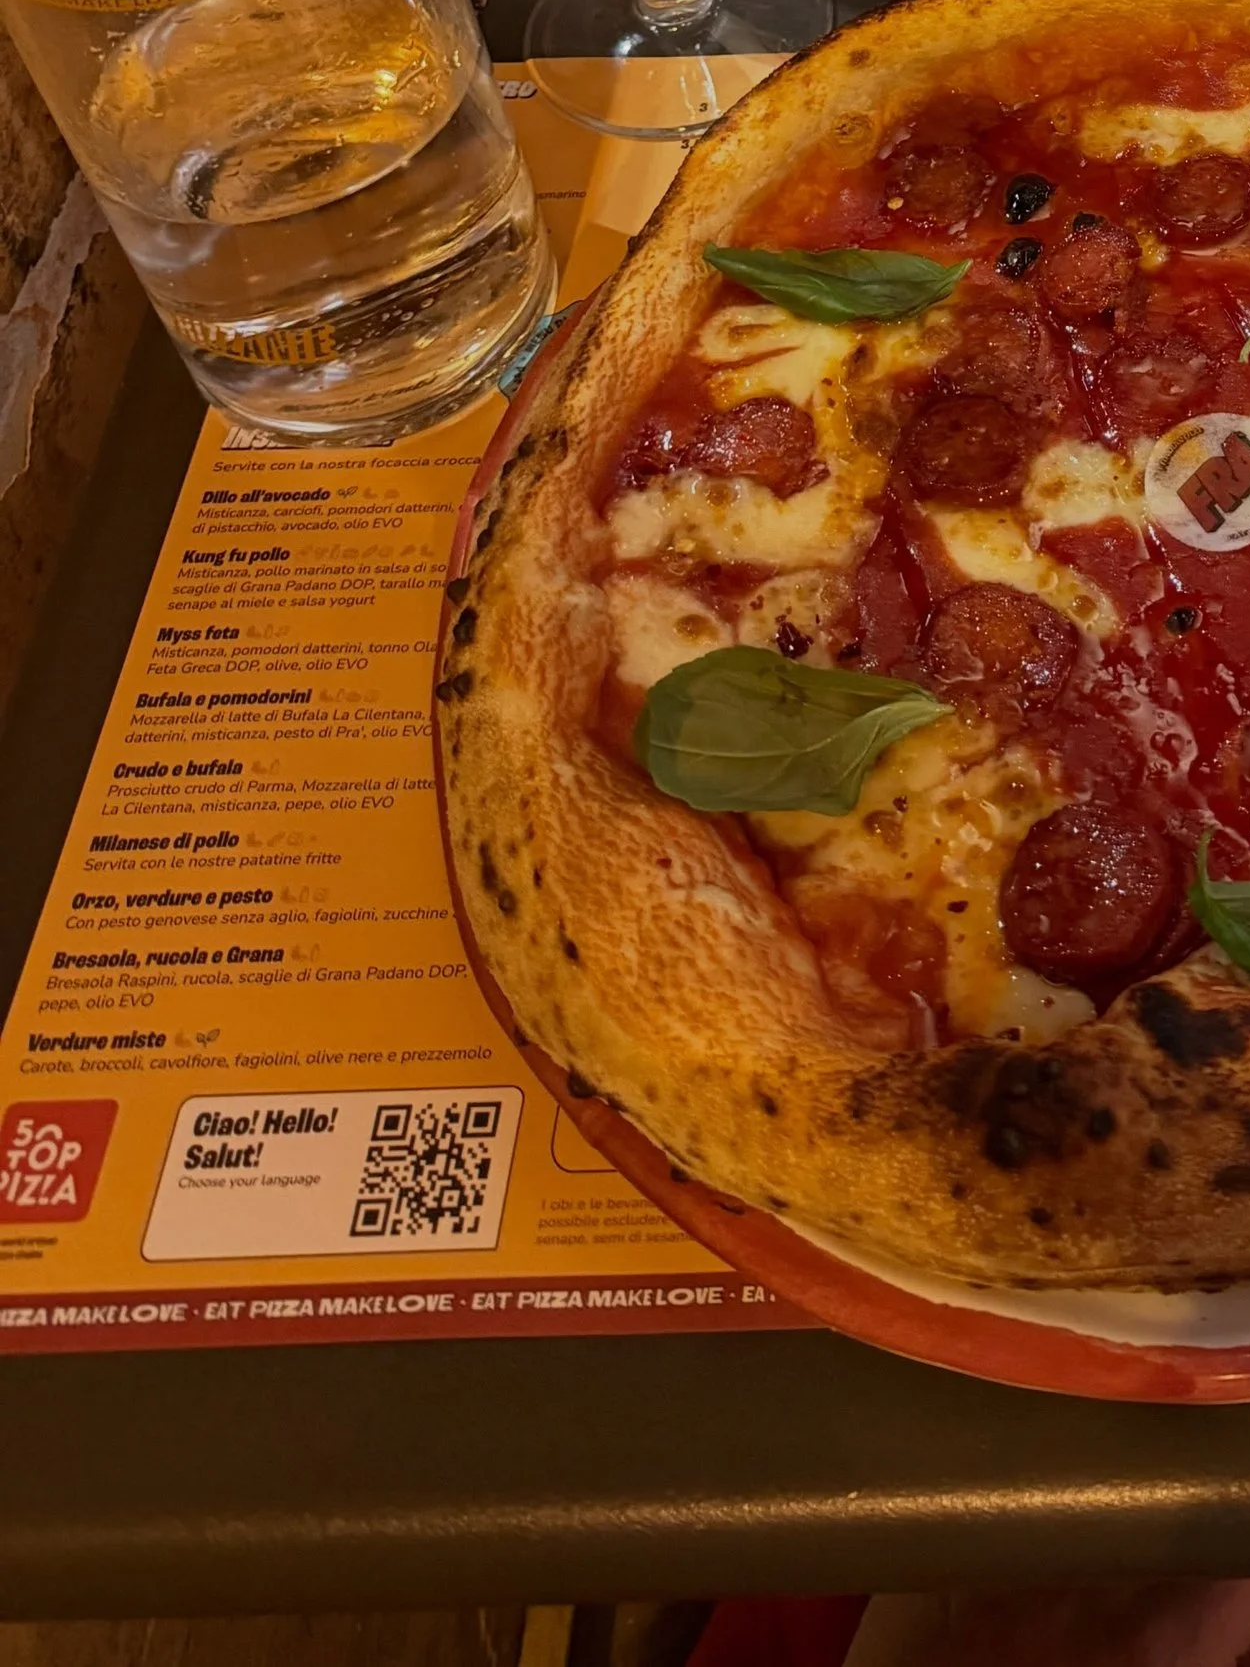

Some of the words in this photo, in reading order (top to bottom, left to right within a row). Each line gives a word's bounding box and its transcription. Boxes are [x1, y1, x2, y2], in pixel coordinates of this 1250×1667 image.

[212, 461, 266, 472] Servite
[269, 462, 296, 470] con
[299, 460, 314, 470] la
[316, 460, 366, 470] nostra
[370, 457, 429, 468] focaccia
[434, 455, 481, 466] crocca
[201, 490, 237, 504] Dillo
[240, 487, 331, 502] all'avocado
[191, 522, 206, 534] di
[343, 518, 369, 529] olio
[372, 517, 403, 528] EVO
[182, 550, 227, 566] Kung
[228, 547, 247, 562] fu
[247, 546, 290, 565] pollo
[156, 627, 202, 645] Myss
[204, 625, 239, 640] feta
[146, 663, 177, 674] Feta
[181, 661, 221, 674] Greca
[305, 659, 332, 670] olio
[336, 658, 368, 670] EVO
[135, 691, 192, 708] Bufala
[195, 694, 206, 706] e
[207, 688, 312, 710] pomodorini
[113, 761, 168, 779] Crudo
[171, 764, 183, 776] e
[185, 759, 243, 776] bufala
[89, 834, 170, 852] Milanese
[173, 832, 192, 849] di
[192, 831, 239, 853] pollo
[126, 890, 202, 907] verdure
[205, 892, 217, 905] e
[218, 888, 273, 909] pesto
[145, 947, 208, 966] rucola
[211, 950, 223, 963] e
[226, 946, 284, 963] Grana
[46, 974, 113, 990] Bresaola
[238, 969, 292, 986] scaglie
[296, 968, 310, 982] di
[315, 968, 361, 982] Grana
[366, 966, 424, 980] Padano
[28, 1032, 108, 1051] Verdure
[110, 1030, 166, 1049] miste
[306, 1050, 343, 1065] olive
[348, 1051, 383, 1063] nere
[386, 1051, 397, 1062] e
[400, 1045, 492, 1064] prezzemolo
[193, 1110, 259, 1136] Ciao!
[262, 1107, 338, 1134] Hello!
[7, 1140, 82, 1170] TOP
[184, 1142, 263, 1169] Salut!
[178, 1177, 226, 1189] Choose
[229, 1177, 258, 1190] your
[260, 1174, 321, 1187] language
[0, 1307, 48, 1328] IZZA
[204, 1301, 246, 1321] EAT
[249, 1299, 315, 1318] PIZZA
[471, 1291, 513, 1311] EAT
[517, 1290, 584, 1310] PIZZA
[741, 1285, 776, 1304] EA
